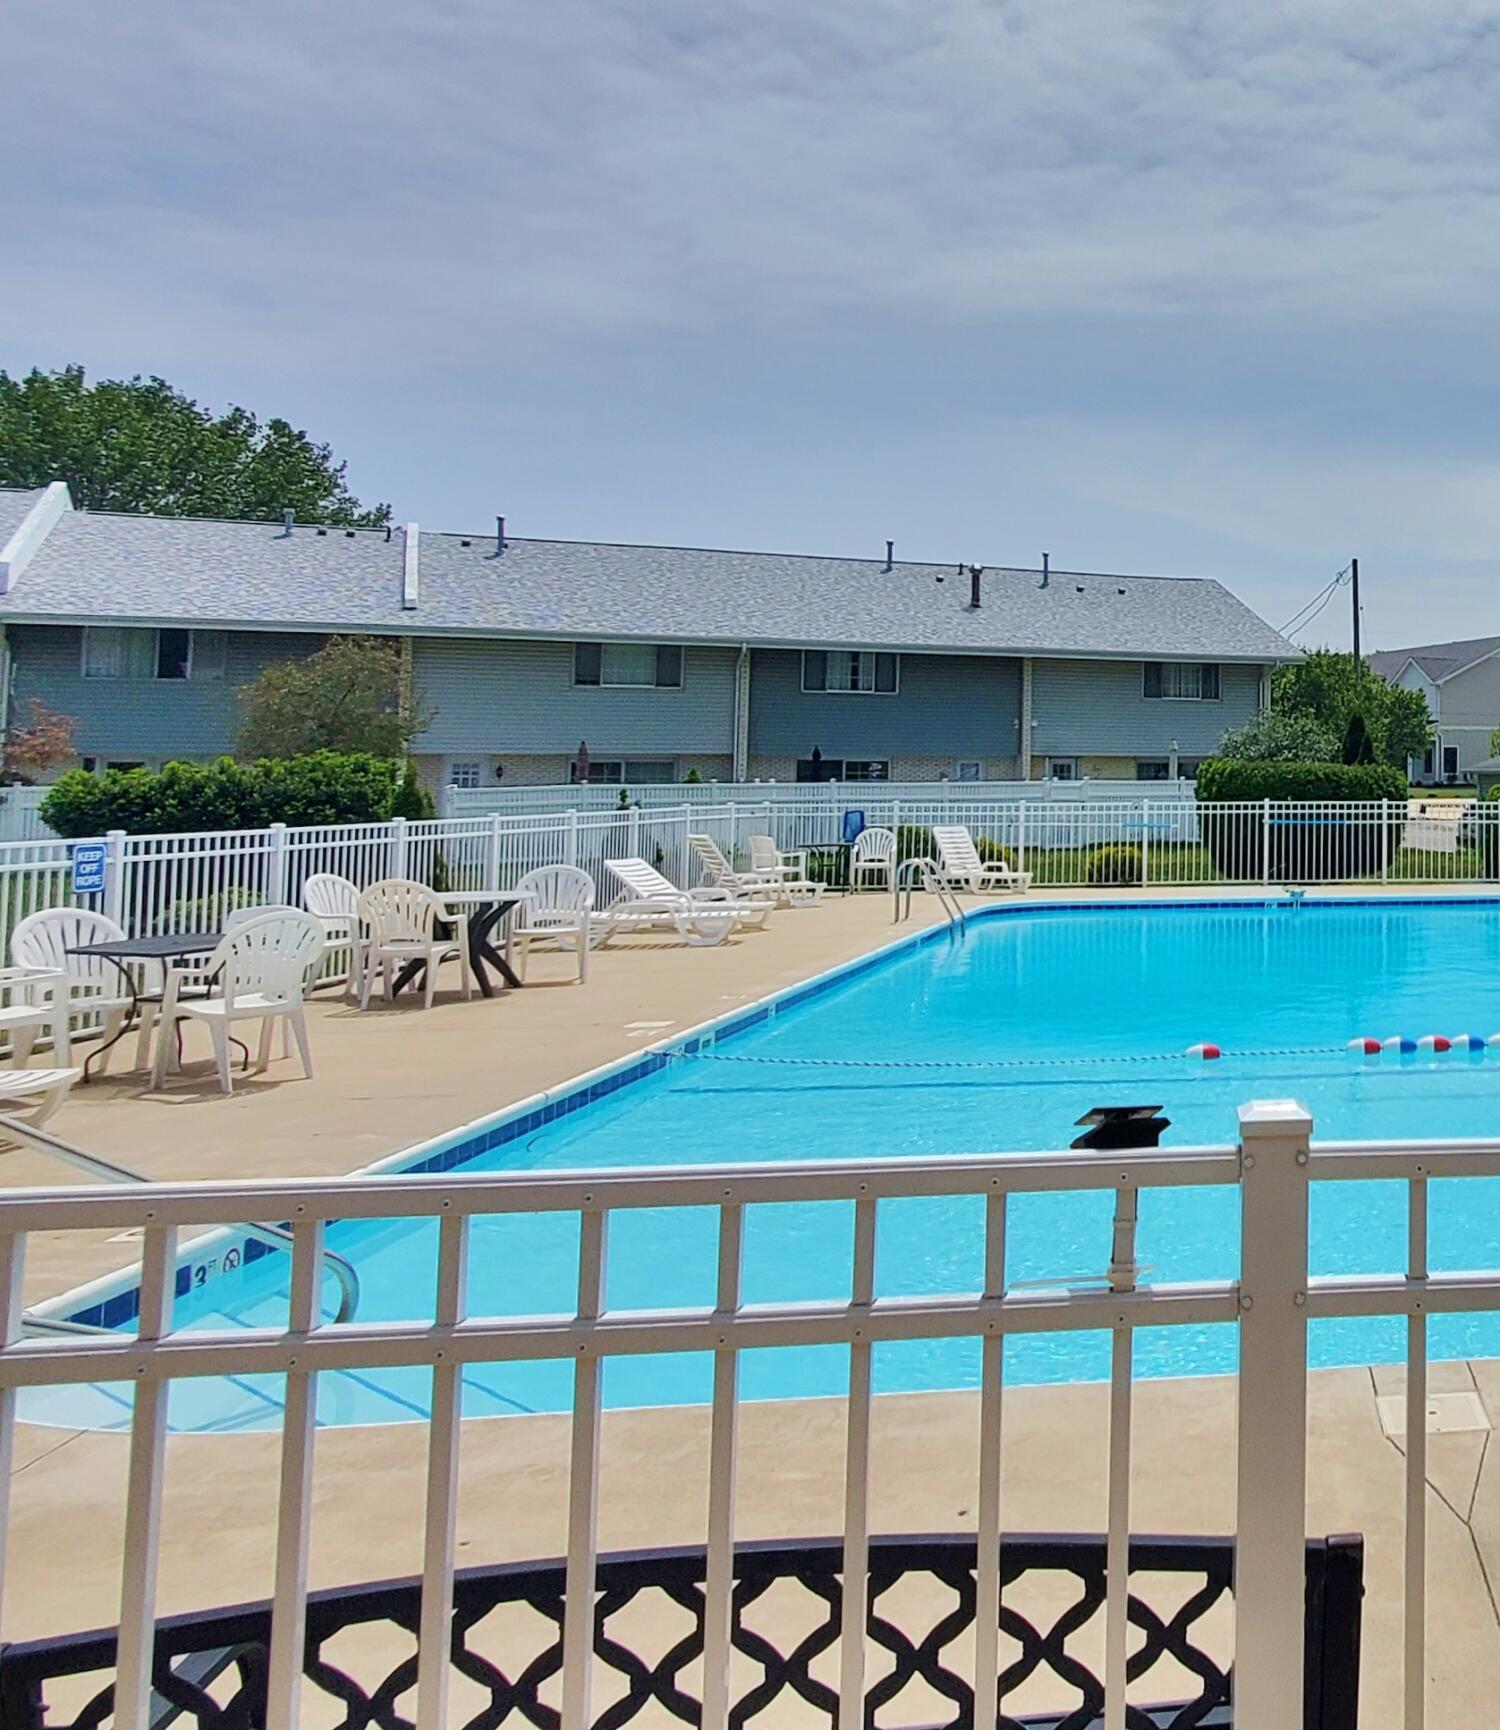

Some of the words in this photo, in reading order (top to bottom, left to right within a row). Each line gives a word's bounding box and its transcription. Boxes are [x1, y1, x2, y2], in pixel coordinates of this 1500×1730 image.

[77, 851, 102, 861] KEEP
[80, 863, 99, 873] OFF
[76, 874, 103, 887] ROPE
[194, 1265, 207, 1288] 3
